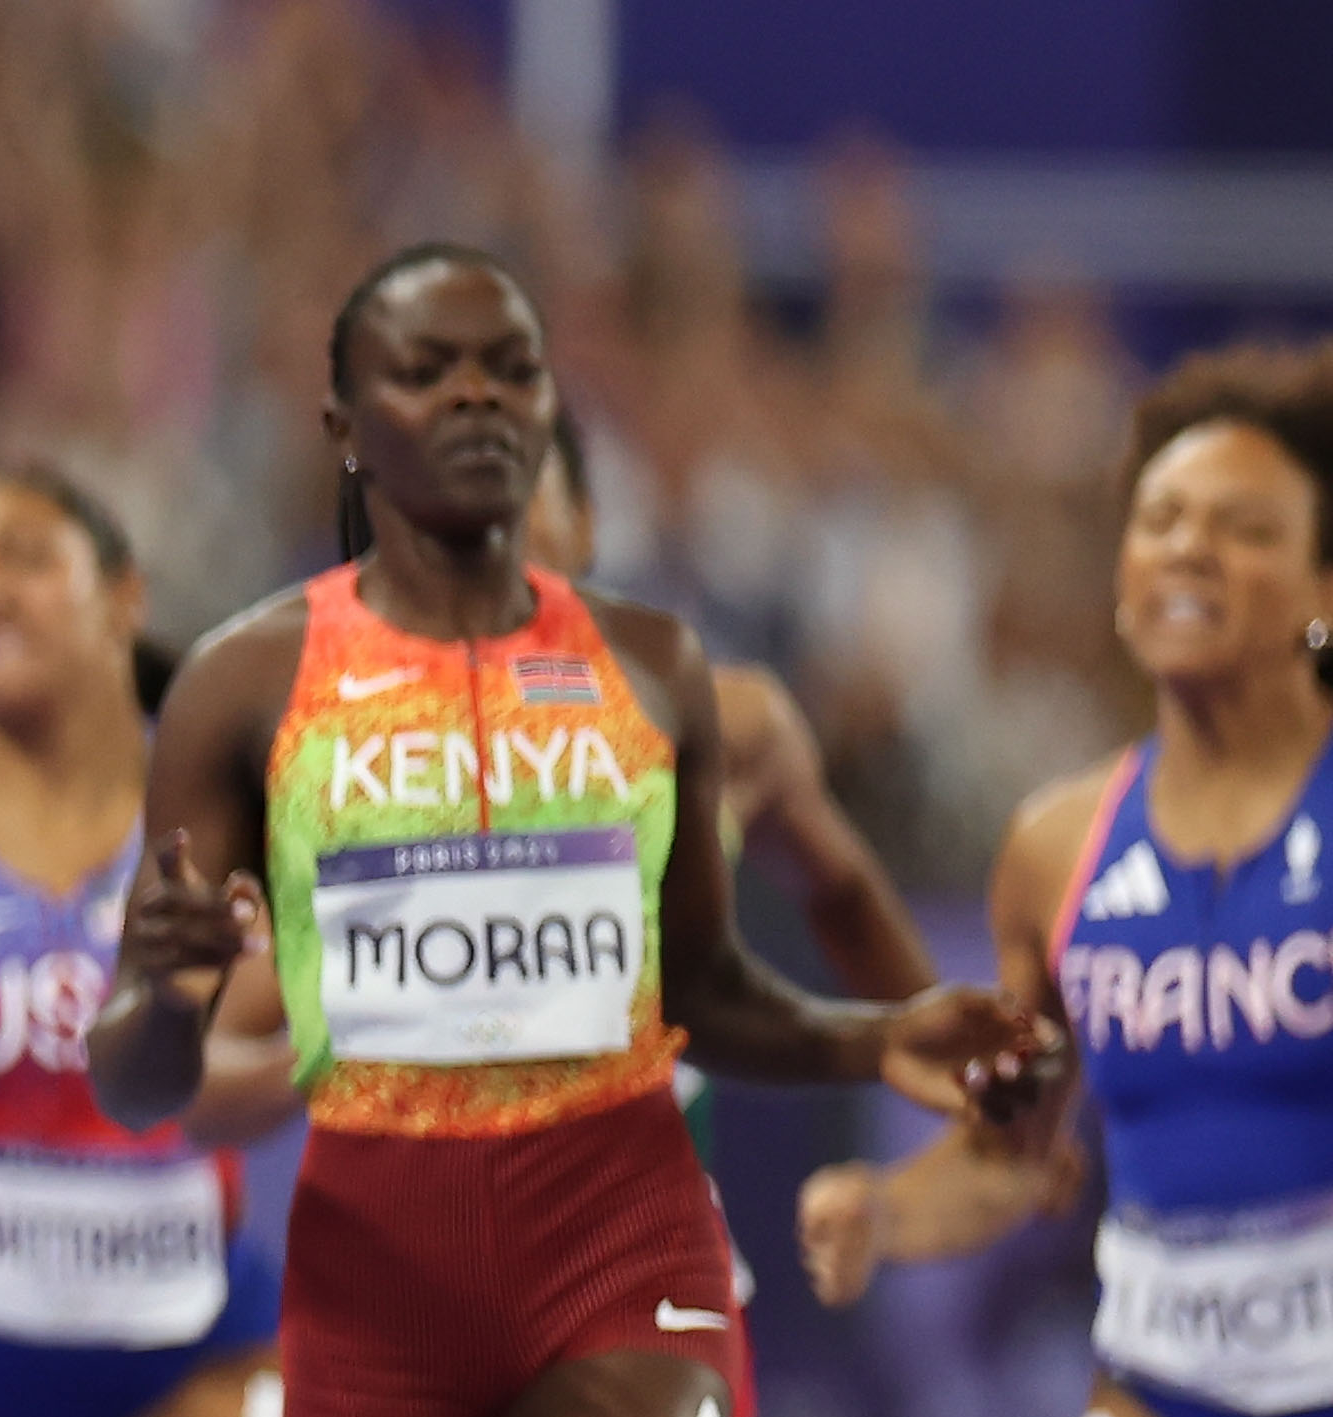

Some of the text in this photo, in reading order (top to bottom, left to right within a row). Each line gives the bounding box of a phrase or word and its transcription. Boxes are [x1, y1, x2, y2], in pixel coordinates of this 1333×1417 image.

[329, 726, 632, 810] KENYA
[346, 911, 628, 990] MORAA
[1060, 929, 1333, 1054] FRANC
